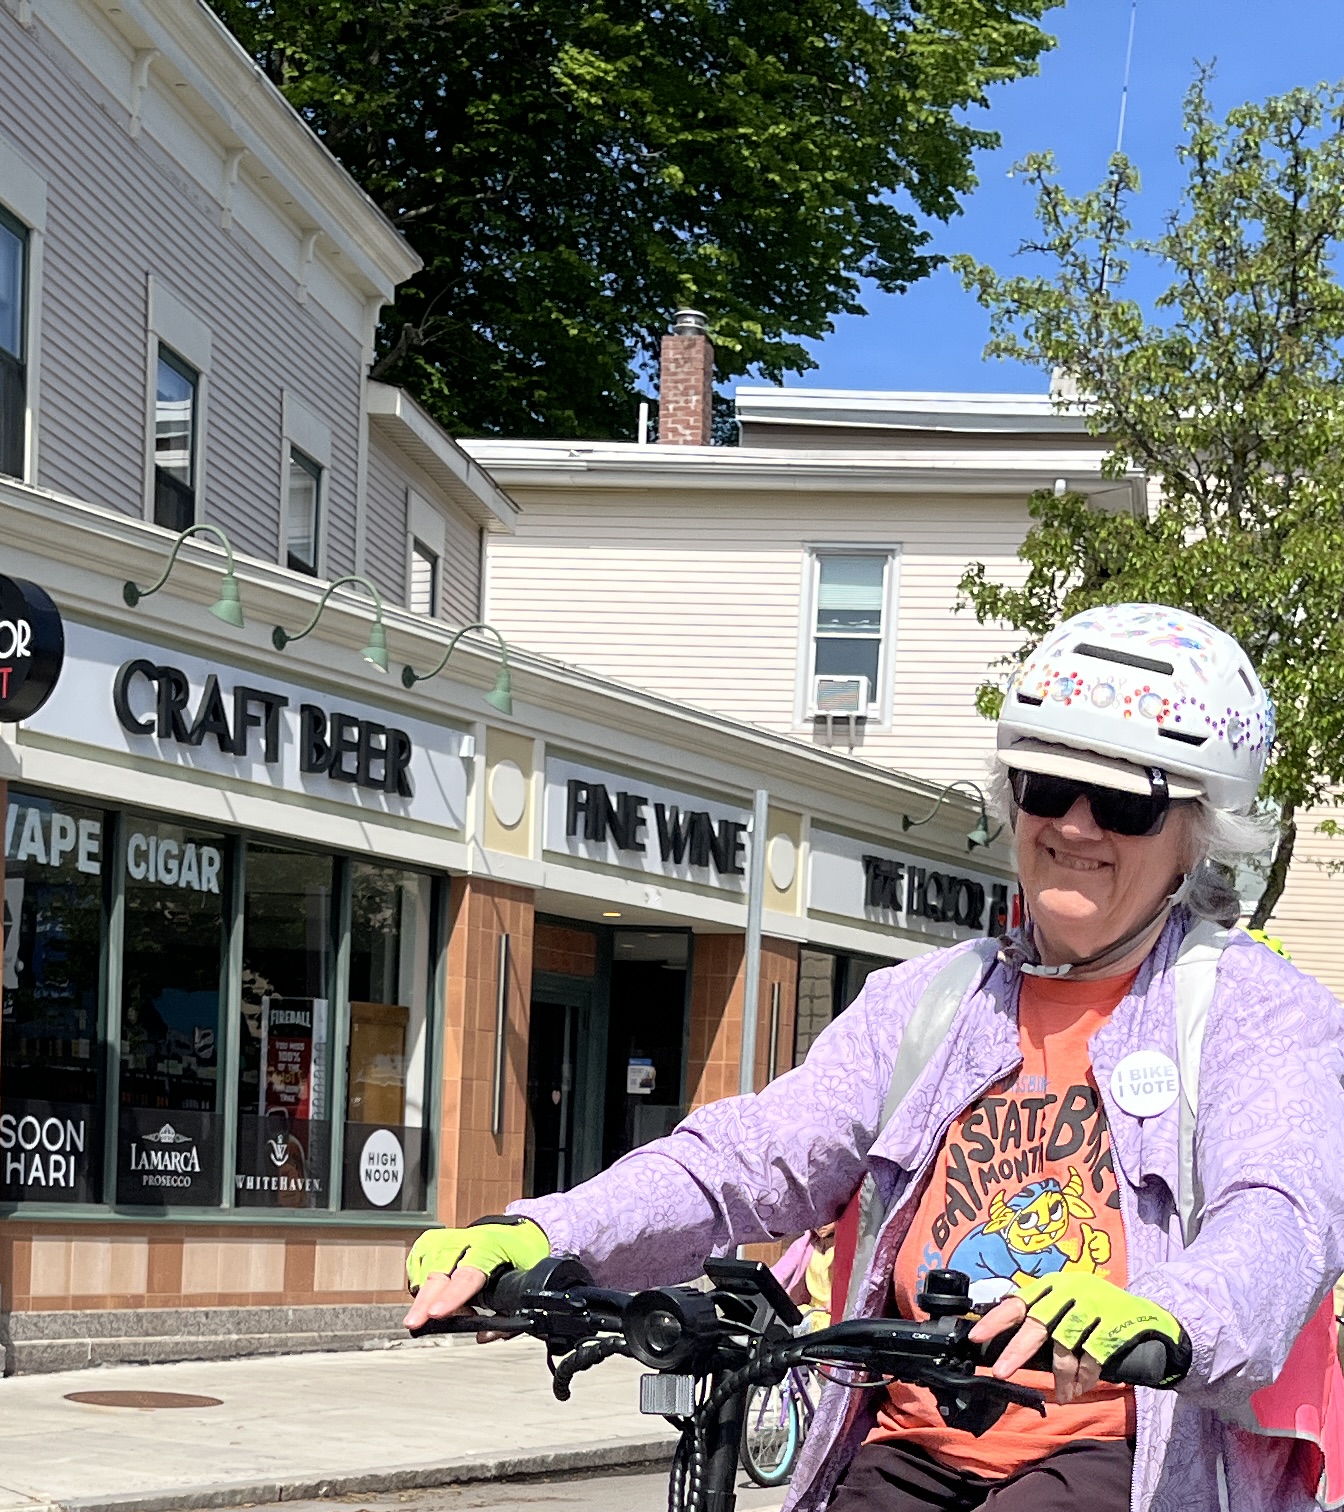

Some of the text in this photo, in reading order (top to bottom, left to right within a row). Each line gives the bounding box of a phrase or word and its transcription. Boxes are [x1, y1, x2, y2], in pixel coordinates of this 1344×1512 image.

[114, 658, 414, 798] CRAFT BEER
[566, 778, 748, 876] FINE WINE
[127, 832, 220, 894] CIGAR
[270, 1009, 311, 1028] FIREBALL
[1129, 1064, 1174, 1080] BIKE
[1130, 1080, 1177, 1095] VOTE
[0, 1114, 84, 1153] SOON
[6, 1152, 75, 1188] HARI
[368, 1152, 397, 1166] HIGH
[142, 1174, 192, 1188] PROSECCO
[364, 1168, 398, 1183] NOON
[932, 1144, 982, 1249] BAY
